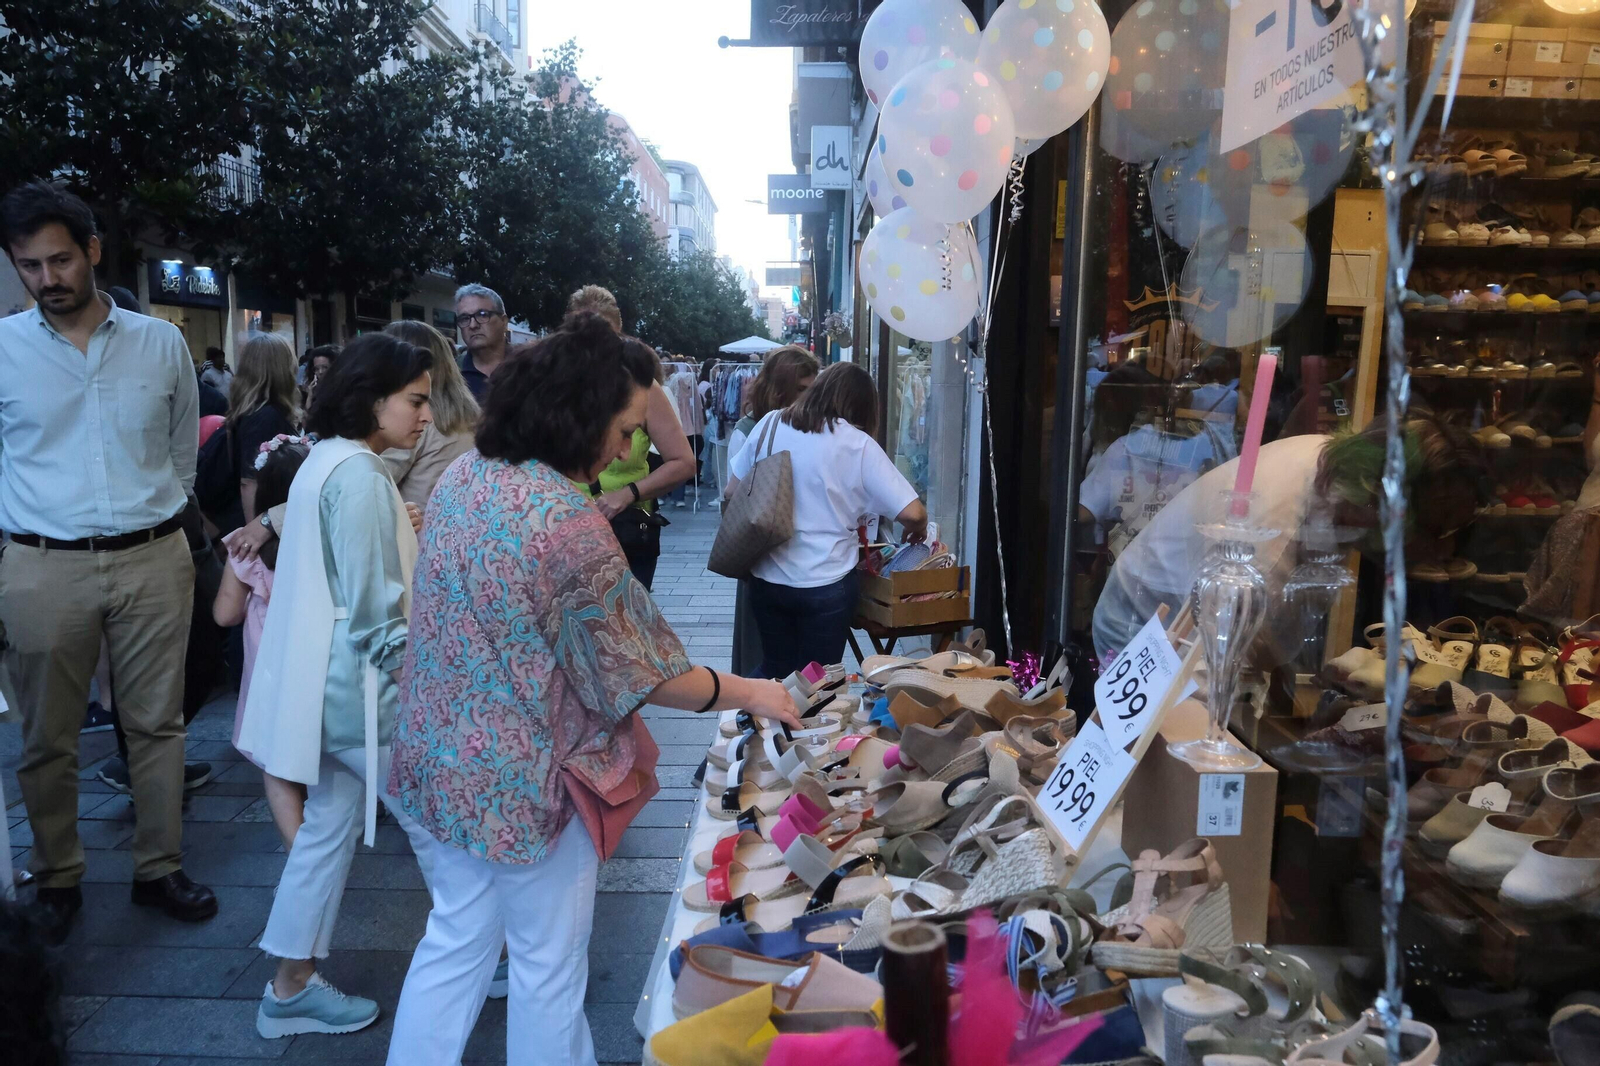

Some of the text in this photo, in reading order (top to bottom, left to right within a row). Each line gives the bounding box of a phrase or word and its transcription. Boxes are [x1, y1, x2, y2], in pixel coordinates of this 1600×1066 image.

[769, 4, 853, 33] Zapateros
[1254, 78, 1267, 99] EN
[1269, 54, 1301, 89] TODOS
[1276, 63, 1334, 114] ARTÍCULOS
[770, 188, 825, 199] moone
[1134, 646, 1157, 684] PIEL
[1076, 751, 1102, 783] PIEL
[1208, 815, 1218, 826] 37
